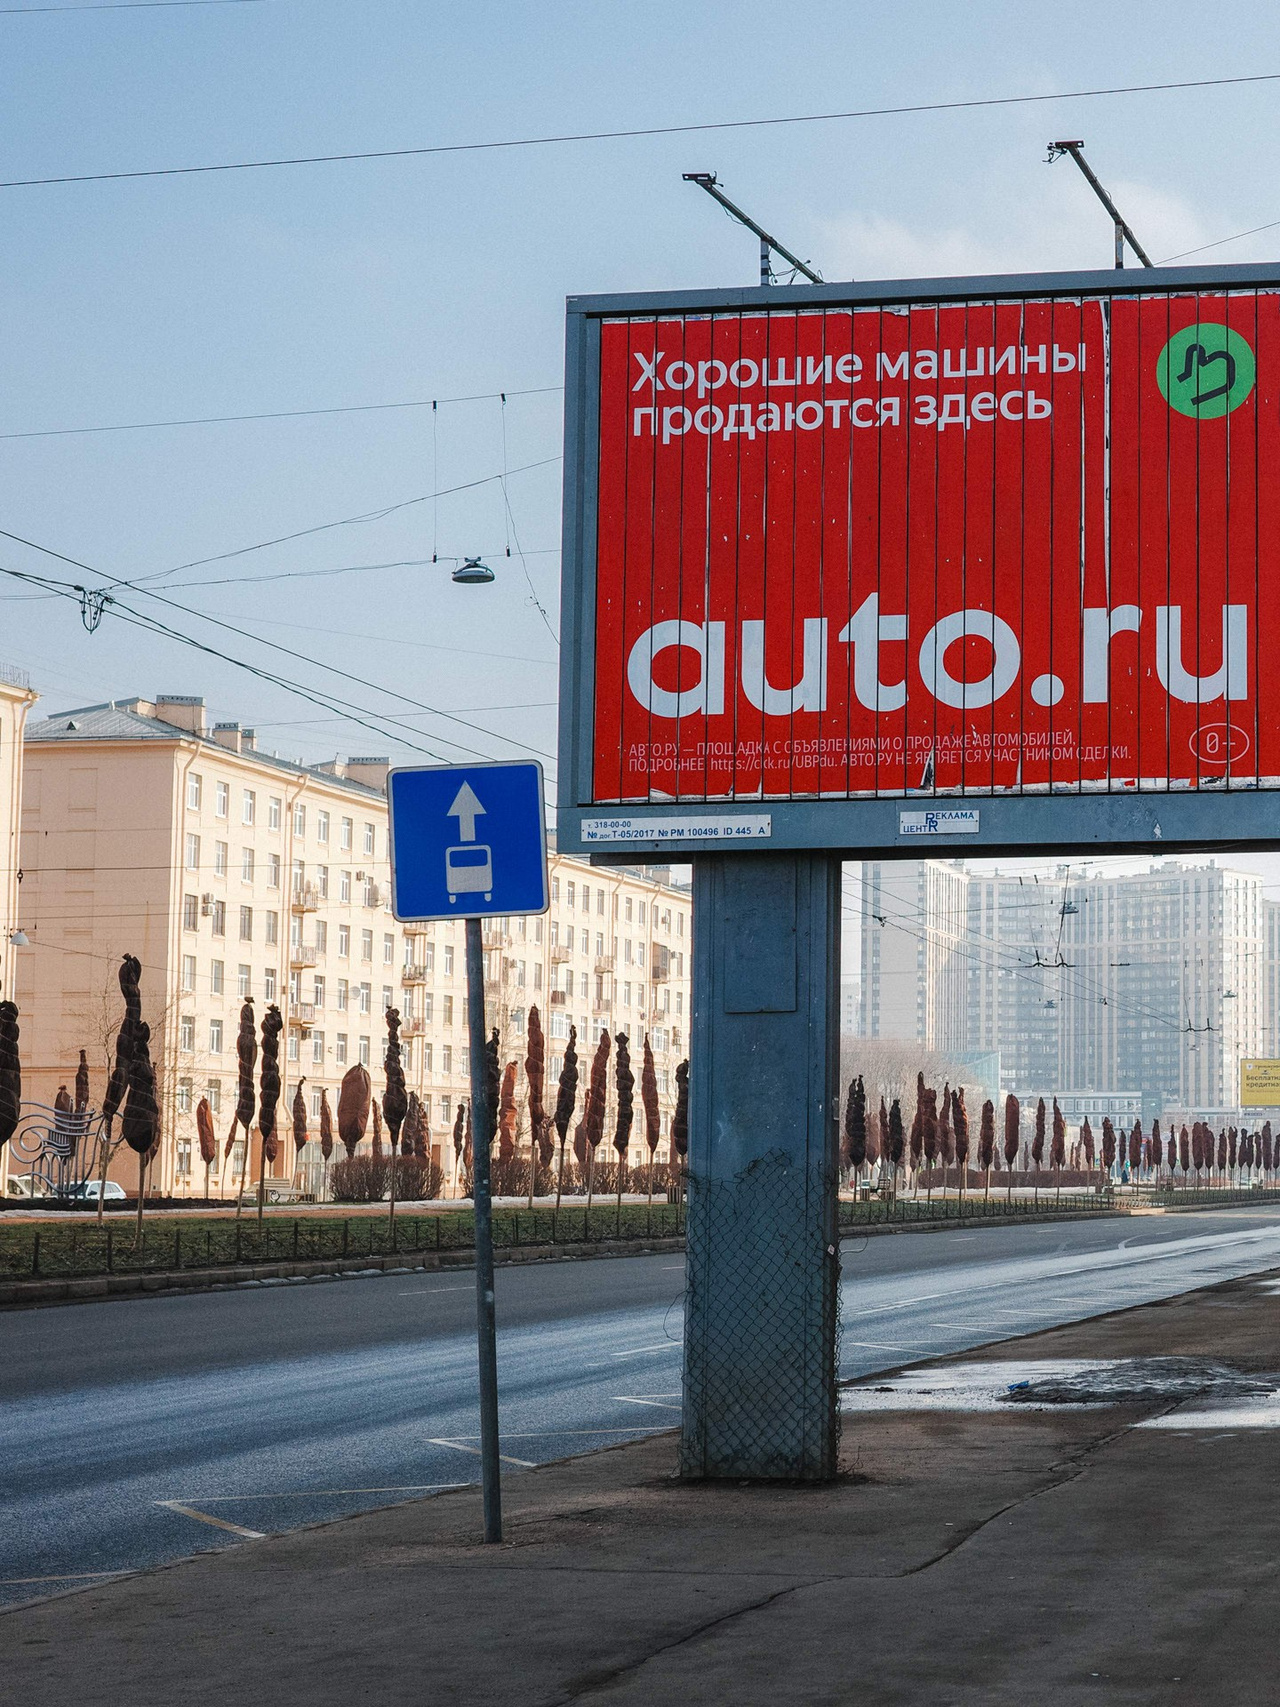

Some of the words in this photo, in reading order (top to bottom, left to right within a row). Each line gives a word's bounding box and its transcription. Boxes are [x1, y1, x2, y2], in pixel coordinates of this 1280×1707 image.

[632, 352, 862, 398] Хорошие
[876, 343, 1086, 383] машины
[632, 396, 900, 445] продаются
[913, 389, 1053, 431] здесь
[627, 592, 1248, 718] auto.ru
[628, 742, 681, 757] АВТО.РУ
[893, 737, 902, 750] О
[906, 733, 972, 751] ПРОДАЖЕ
[840, 752, 893, 767] АВТО.РУ
[896, 752, 912, 766] НЕ
[587, 830, 598, 839] №
[658, 829, 669, 837] №
[687, 827, 719, 836] 100496
[723, 827, 733, 836] ID
[735, 826, 752, 835] 445
[594, 820, 632, 829] 318-00-00
